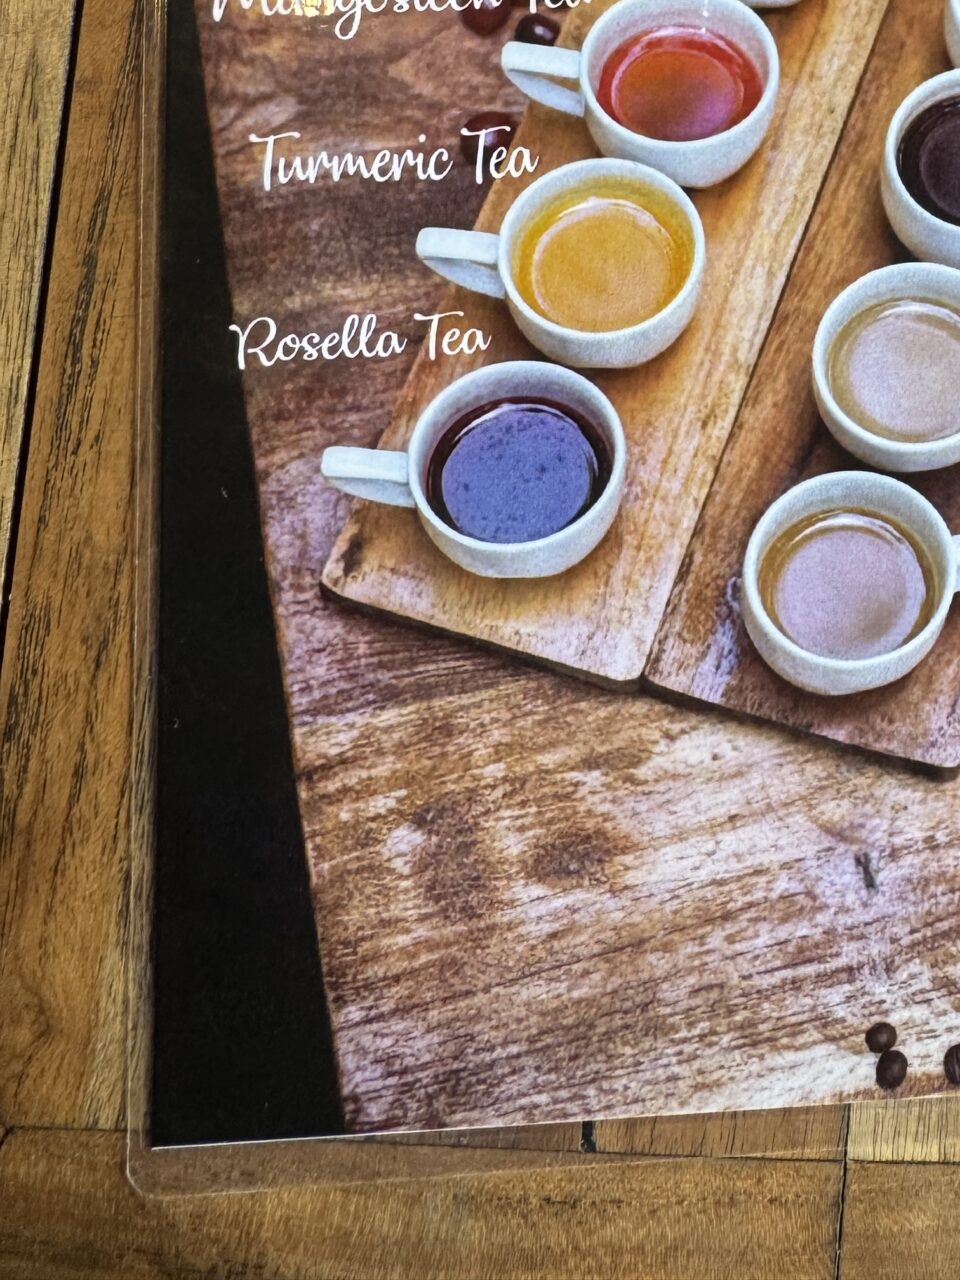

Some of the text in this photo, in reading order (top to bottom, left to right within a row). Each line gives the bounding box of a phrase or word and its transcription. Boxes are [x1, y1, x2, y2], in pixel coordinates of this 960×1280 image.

[249, 126, 539, 191] Turmeric Tea
[229, 311, 491, 370] Rosella Tea
